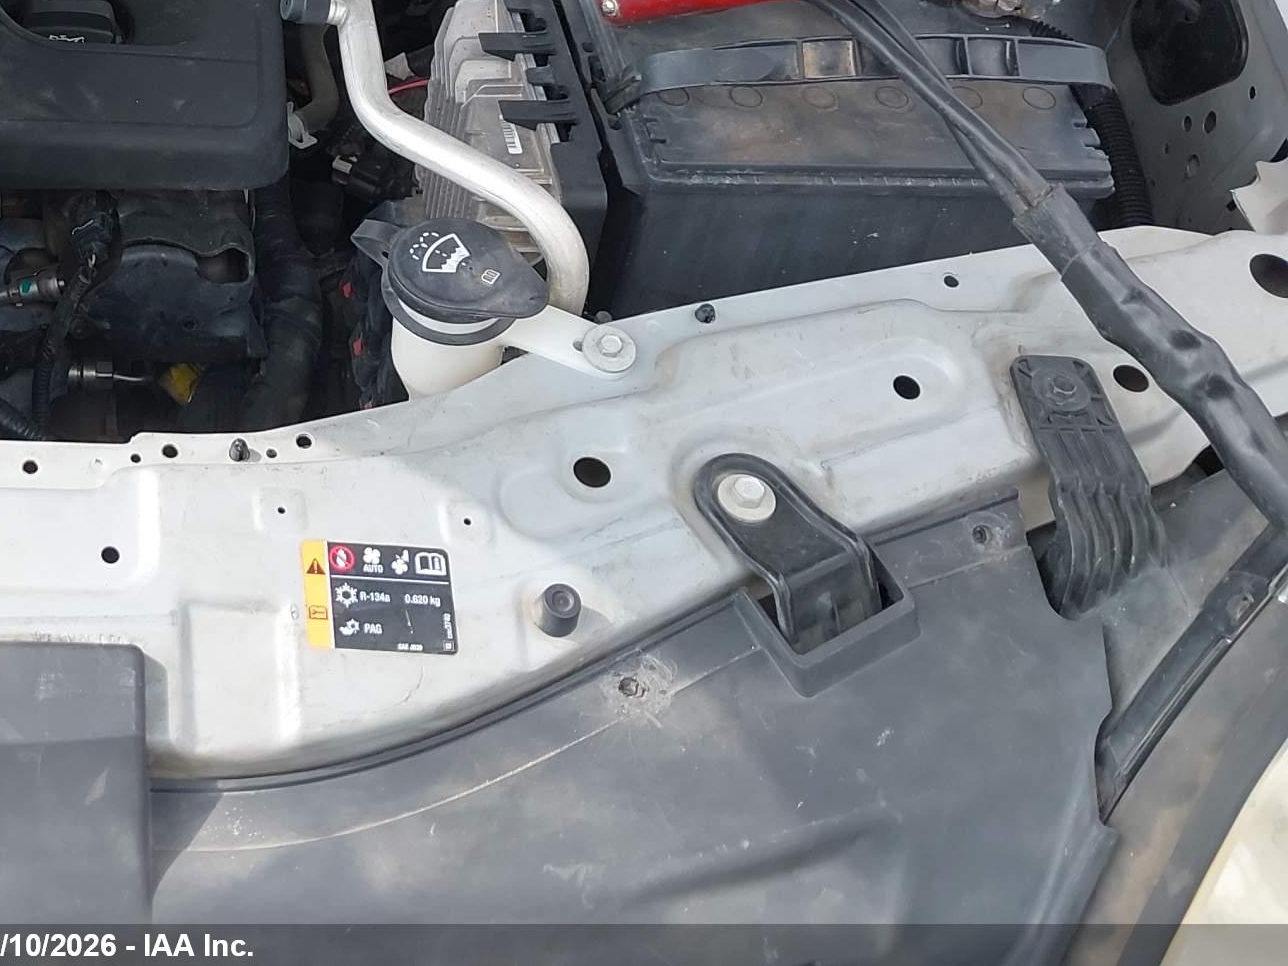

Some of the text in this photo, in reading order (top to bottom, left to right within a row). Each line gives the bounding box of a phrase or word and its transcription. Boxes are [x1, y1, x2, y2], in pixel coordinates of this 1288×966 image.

[363, 564, 383, 573] AUTO
[359, 591, 391, 603] R-134a
[430, 595, 441, 607] kg
[364, 623, 383, 634] PAG
